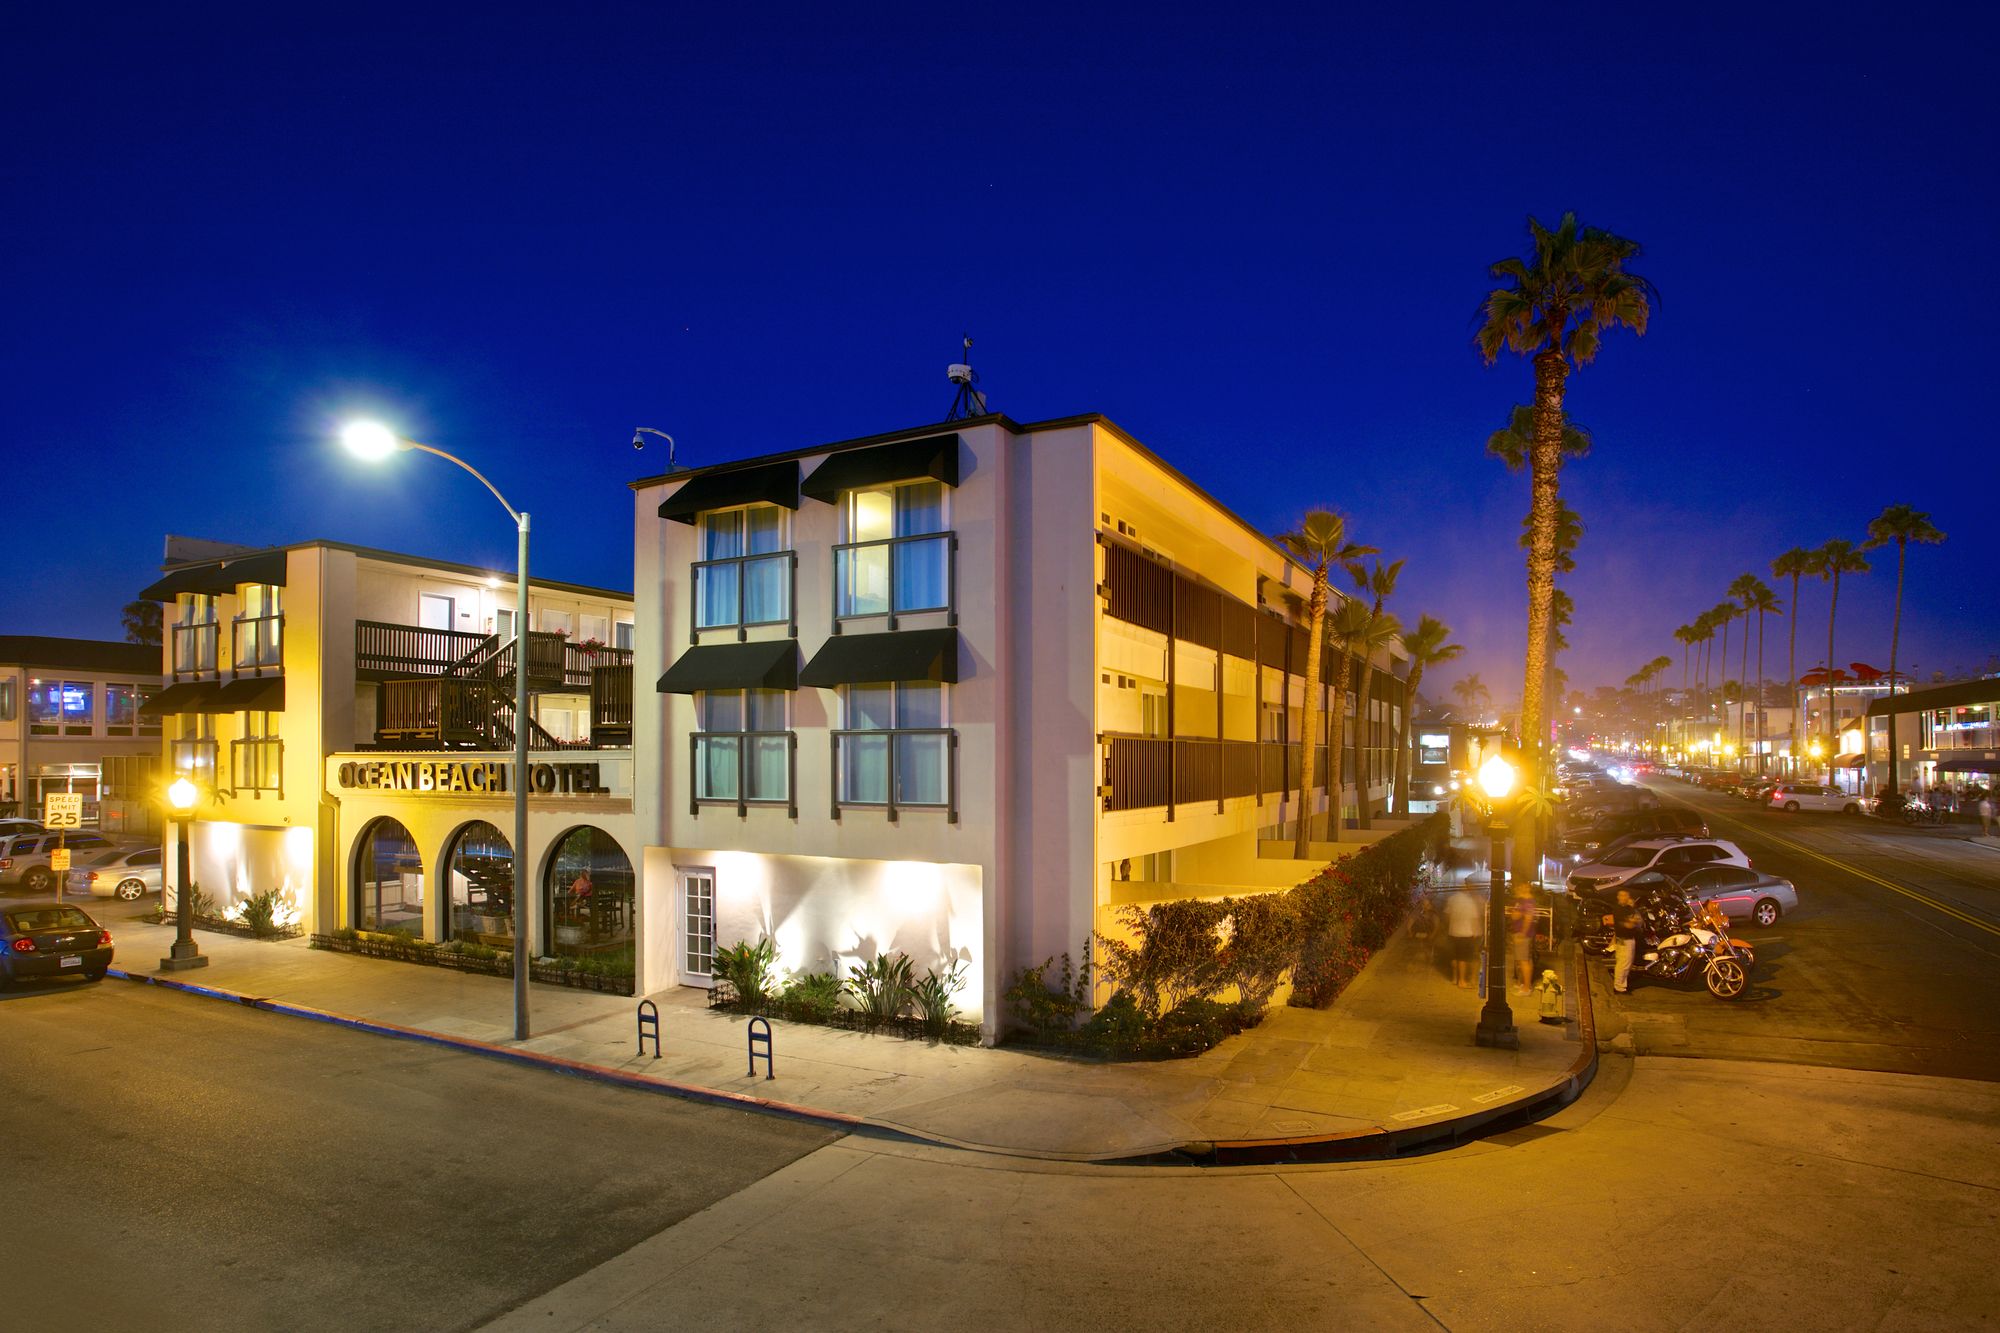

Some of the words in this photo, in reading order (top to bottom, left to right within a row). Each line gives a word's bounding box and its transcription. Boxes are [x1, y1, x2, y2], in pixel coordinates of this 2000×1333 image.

[338, 762, 418, 789] OCEAN
[419, 762, 506, 792] BEACH
[49, 812, 77, 825] 25
